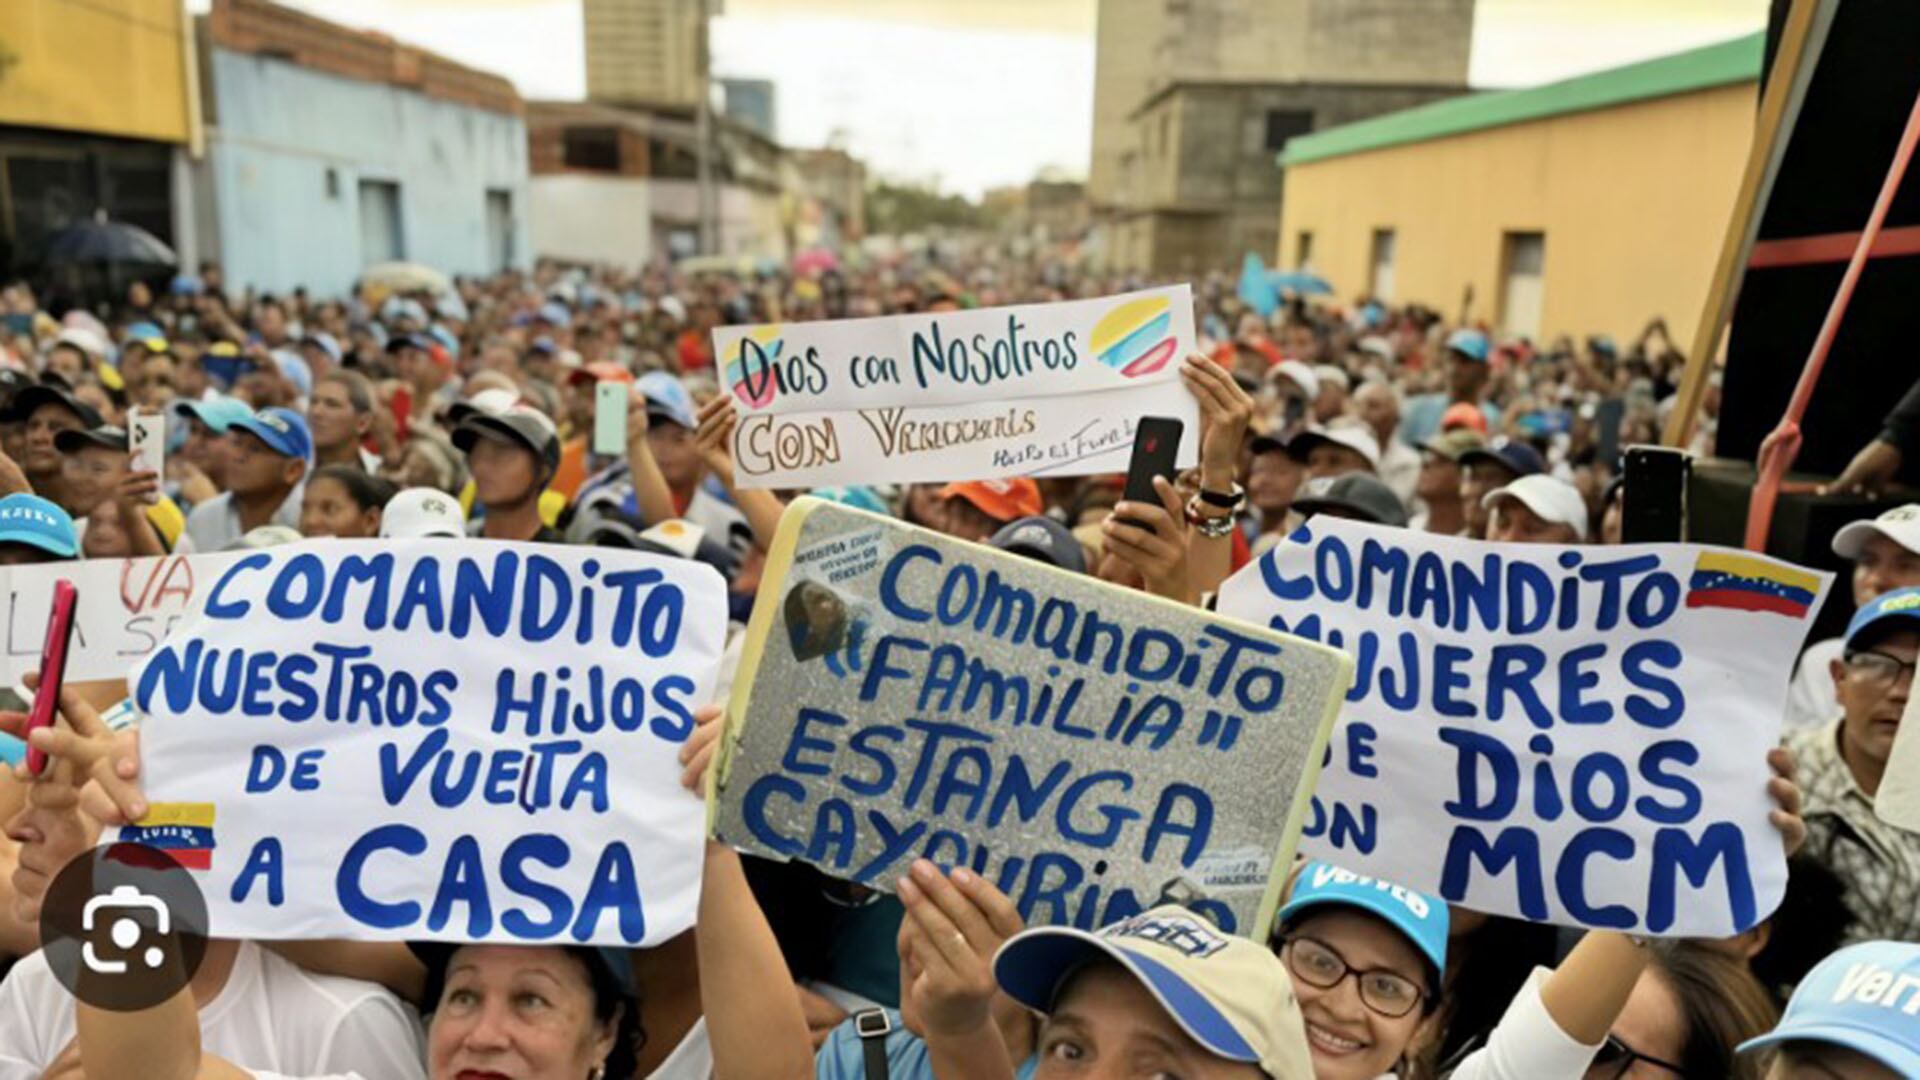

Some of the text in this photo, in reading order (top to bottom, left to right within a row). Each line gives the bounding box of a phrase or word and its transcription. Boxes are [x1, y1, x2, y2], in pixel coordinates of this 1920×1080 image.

[850, 355, 901, 389] con
[912, 314, 1078, 388] Nosotros
[120, 555, 194, 614] VA
[137, 638, 458, 728] NUESTROS
[245, 744, 326, 793] DE
[782, 708, 1214, 869] ESTANGA
[1322, 721, 1378, 778] E
[230, 823, 645, 944] A CASA
[1439, 821, 1758, 934] MCM
